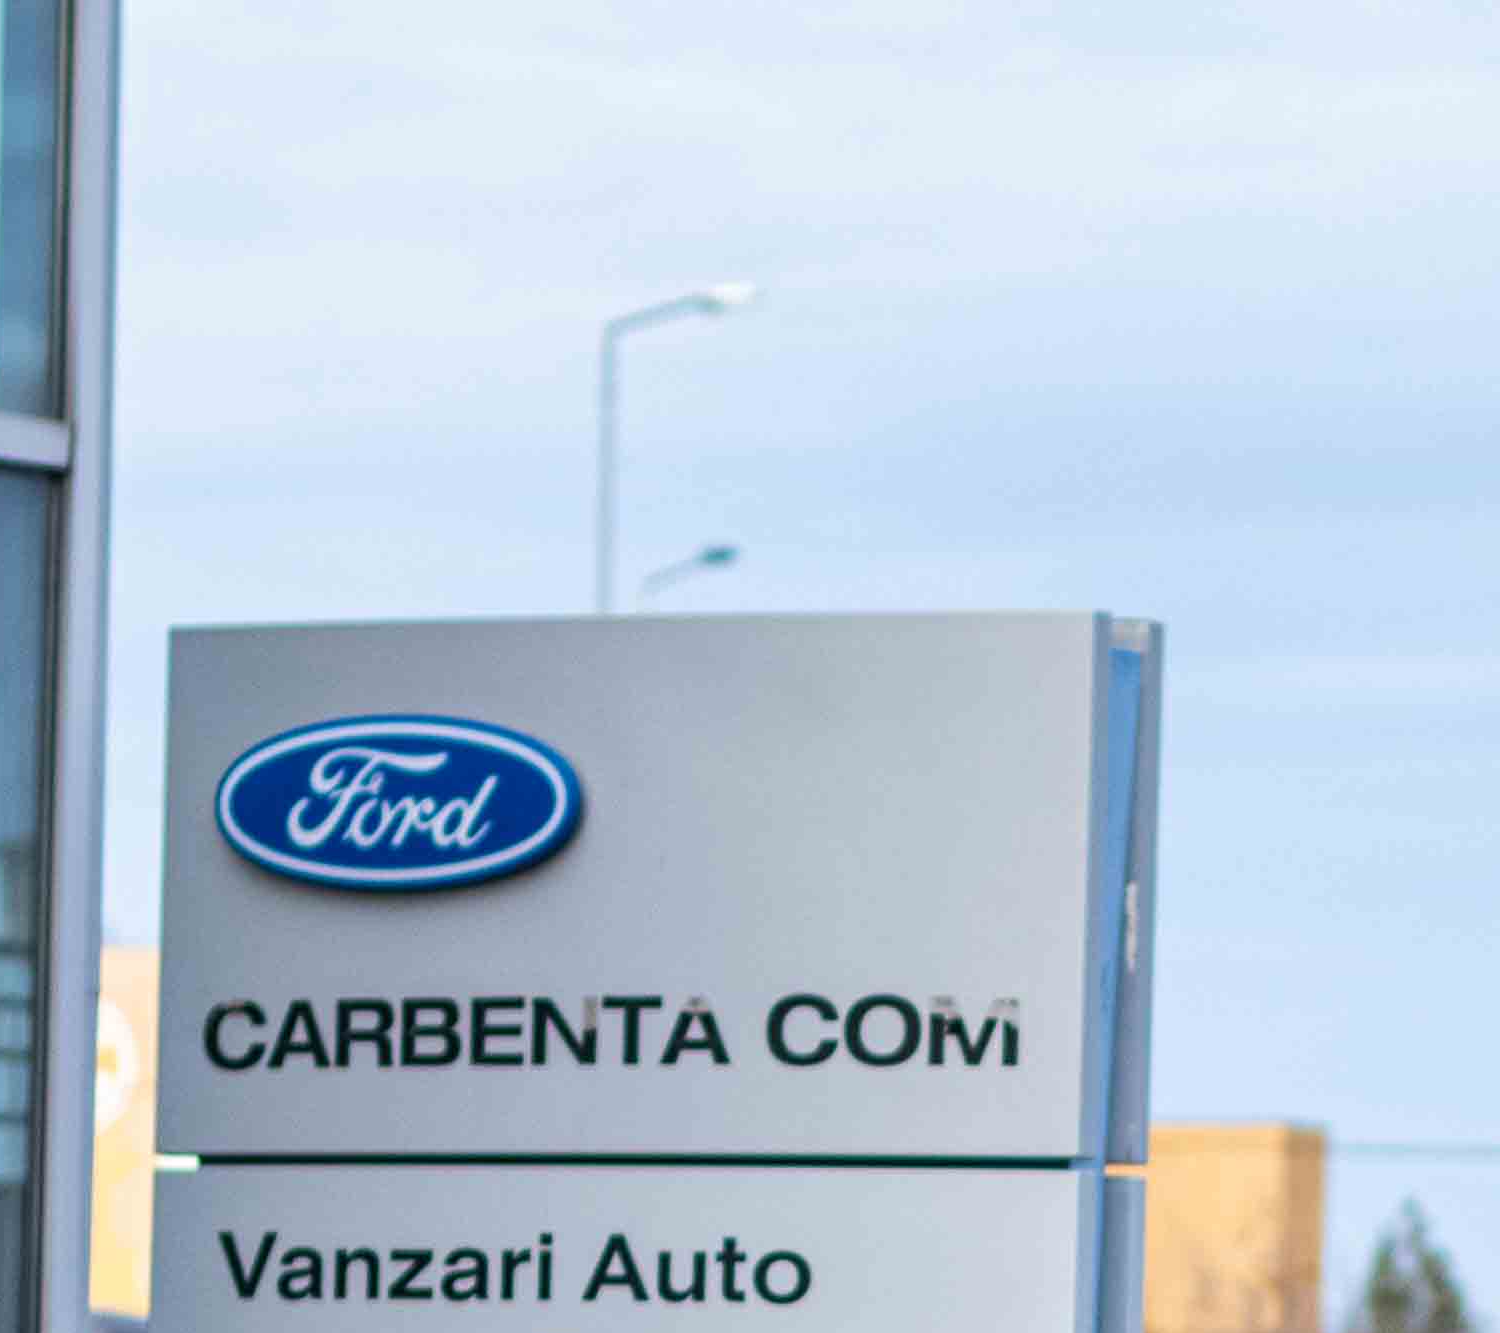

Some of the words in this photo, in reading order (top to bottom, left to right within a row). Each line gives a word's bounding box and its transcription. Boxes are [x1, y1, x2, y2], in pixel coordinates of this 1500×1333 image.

[286, 745, 499, 849] Ford
[203, 994, 731, 1071] CARBENTA
[764, 993, 1020, 1068] COM
[218, 1231, 554, 1302] Vanzari
[582, 1233, 813, 1304] Auto
